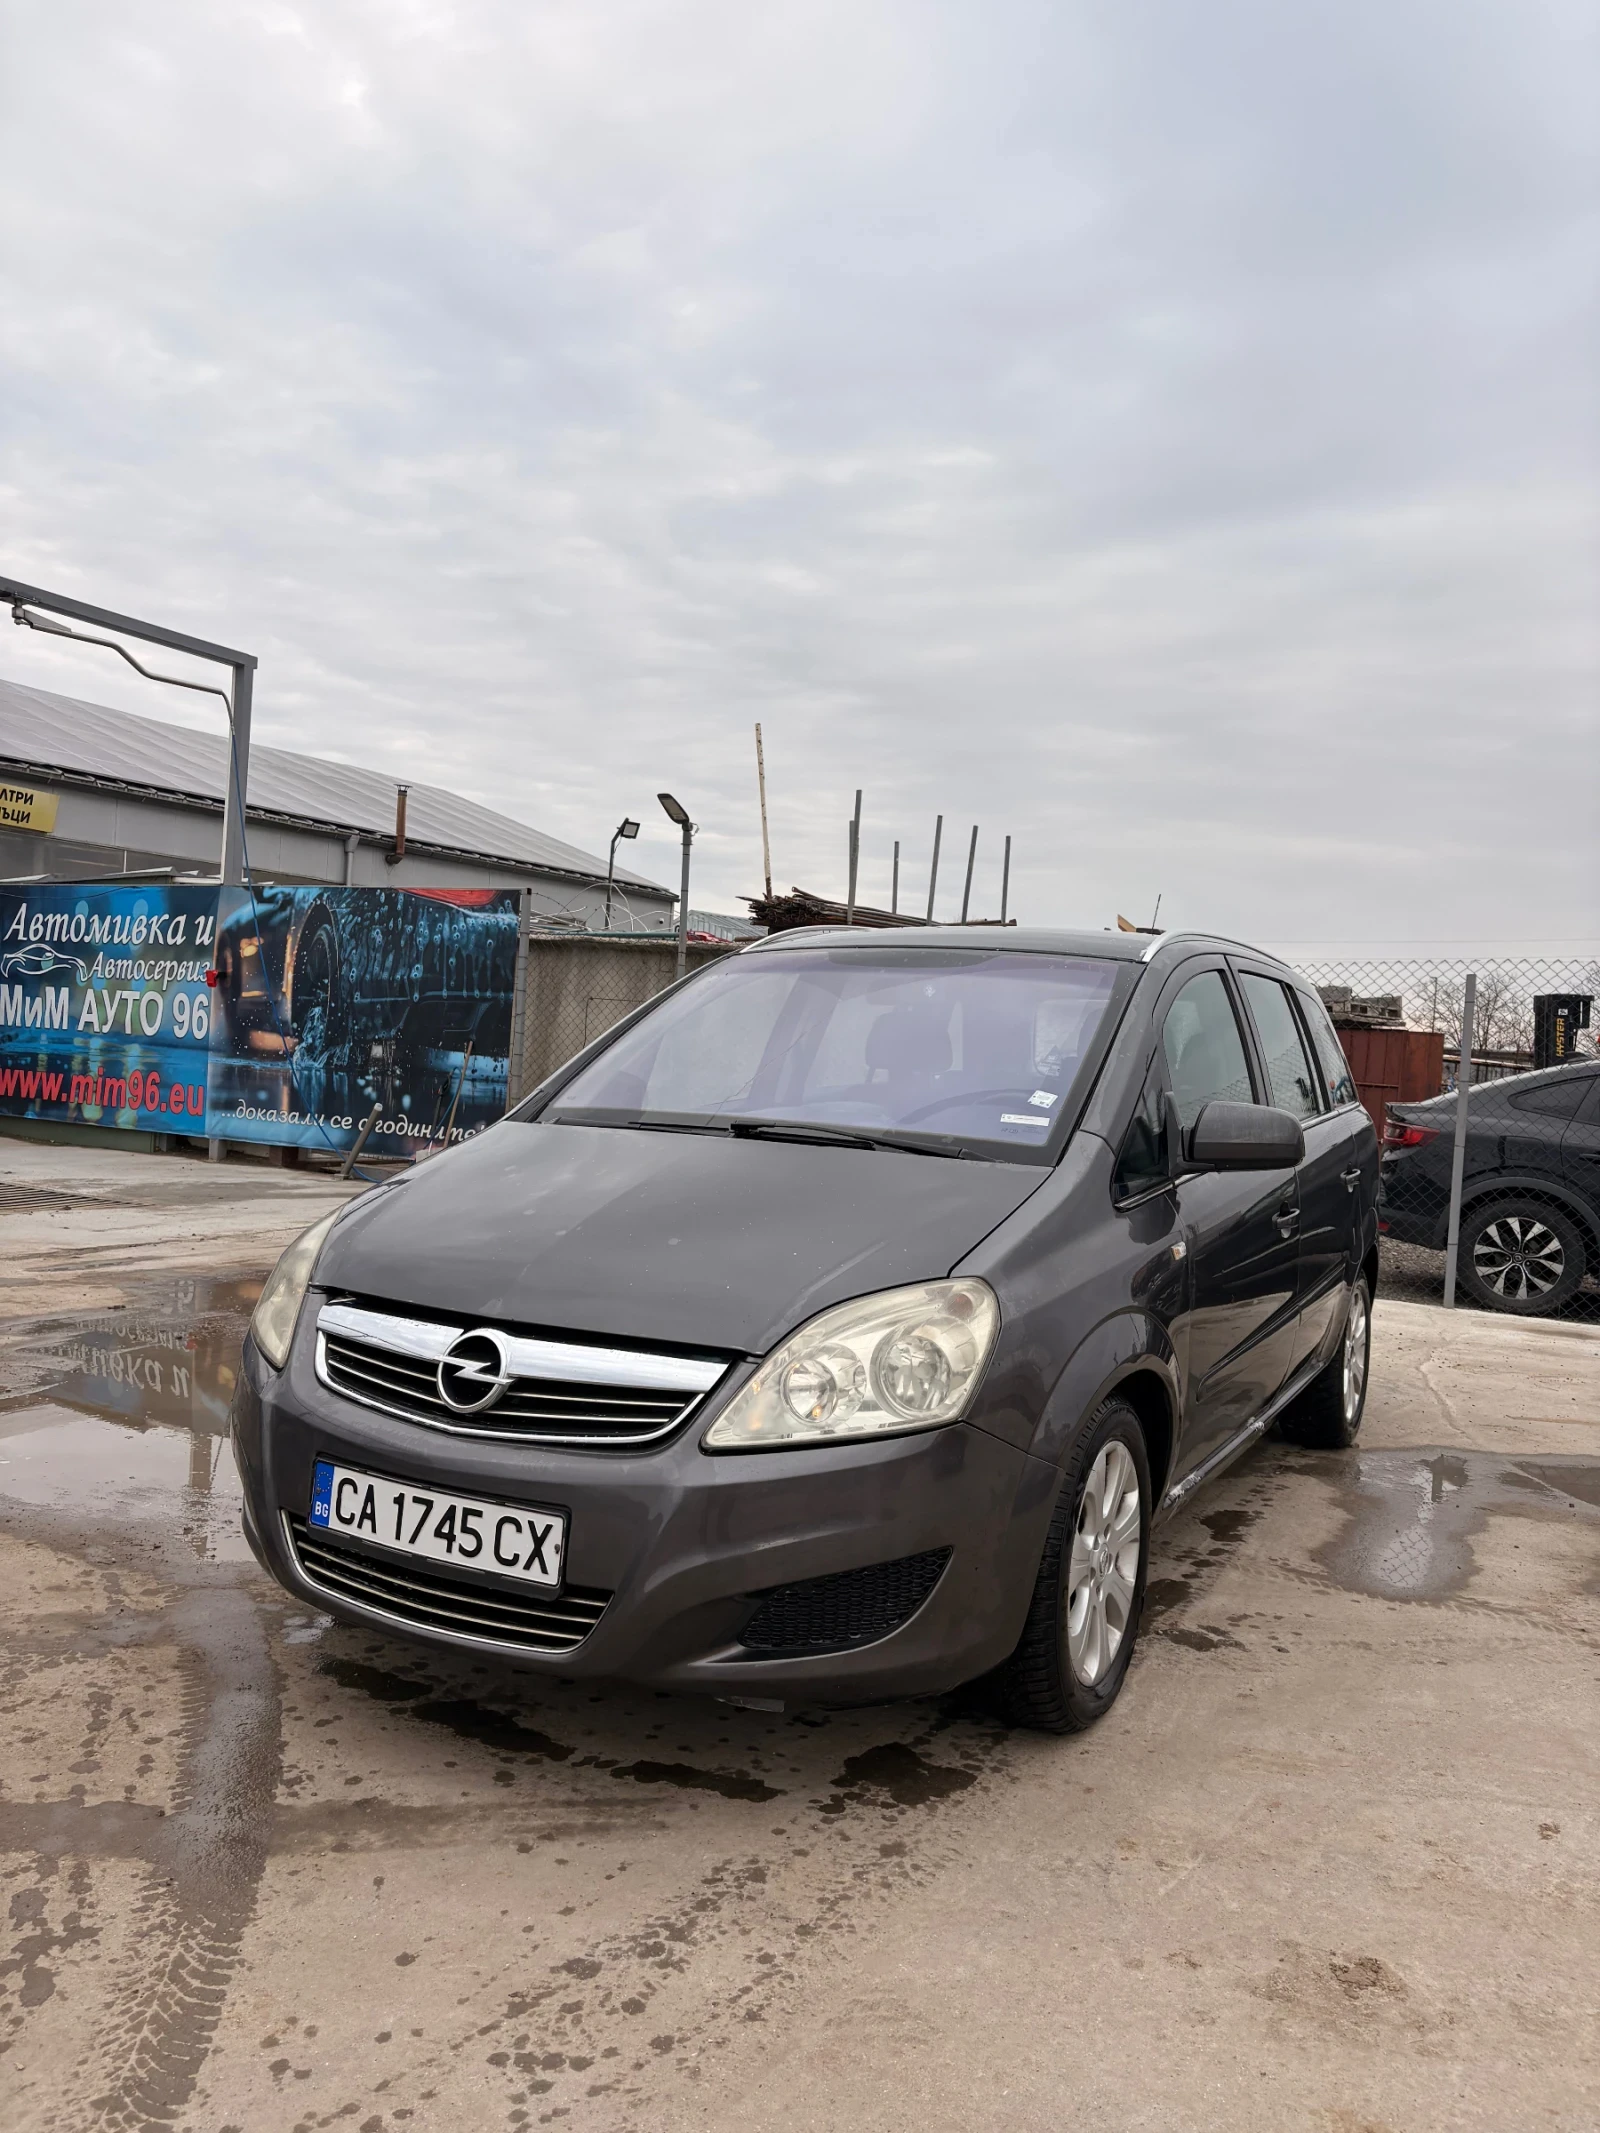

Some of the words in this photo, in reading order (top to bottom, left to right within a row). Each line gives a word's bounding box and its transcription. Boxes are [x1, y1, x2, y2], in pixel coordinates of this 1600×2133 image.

[0, 806, 31, 824] ЪЦИ
[3, 902, 187, 946] Автомивка
[194, 915, 214, 946] и
[88, 951, 211, 991] Автосервиз
[0, 984, 70, 1031] МиМ
[77, 988, 164, 1037] АУТО
[172, 992, 209, 1040] 96
[1556, 1017, 1565, 1057] HYSTER
[0, 1066, 204, 1116] www.mim96.eu
[330, 1115, 353, 1130] се
[314, 1500, 329, 1518] BG
[335, 1477, 377, 1534] CA
[393, 1492, 484, 1558] 1745
[493, 1515, 554, 1575] CX
